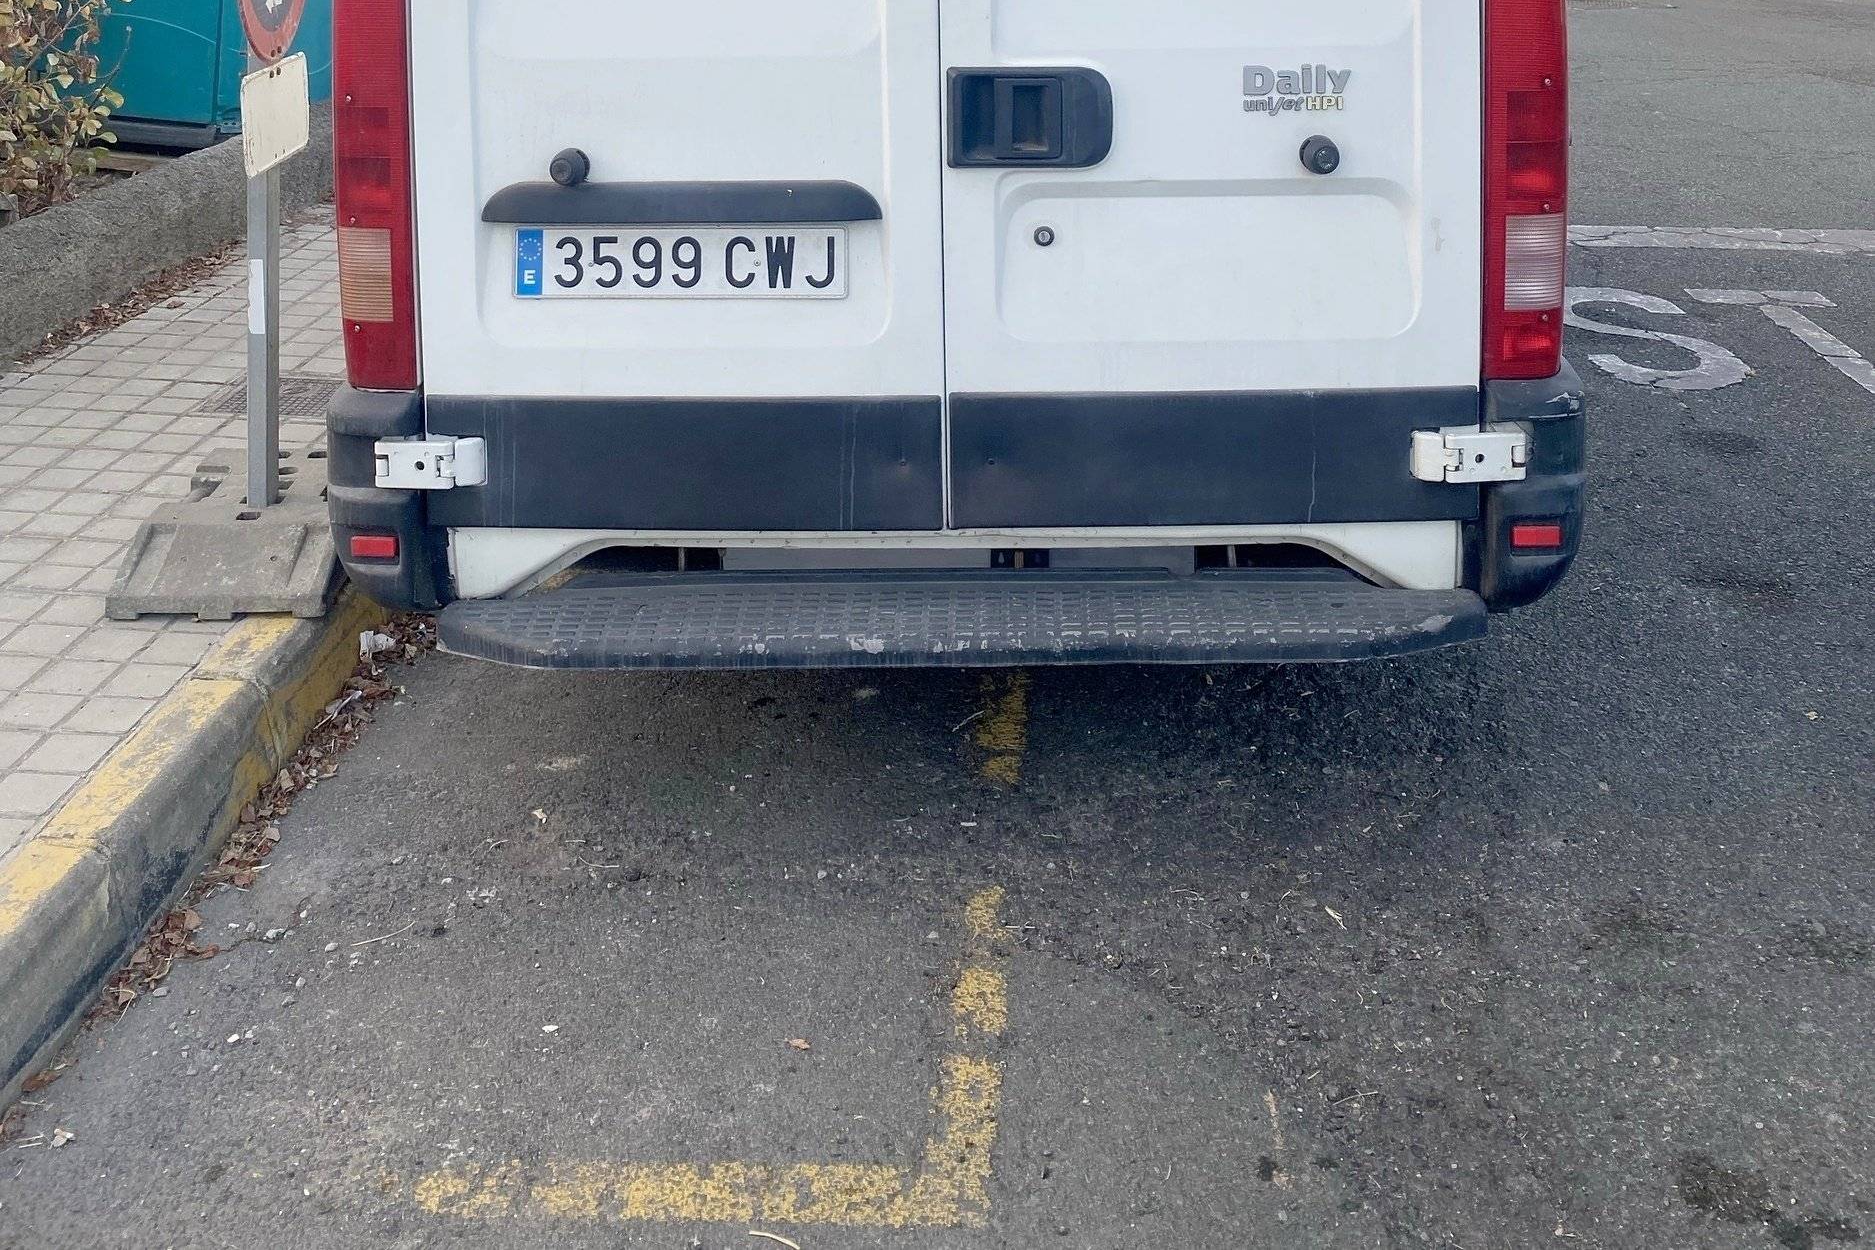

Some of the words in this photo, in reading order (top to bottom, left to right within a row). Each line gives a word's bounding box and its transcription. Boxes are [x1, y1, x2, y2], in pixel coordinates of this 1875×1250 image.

[1243, 63, 1352, 96] Daily
[1306, 95, 1345, 111] HPI
[523, 270, 536, 285] E
[553, 235, 703, 289] 3599
[724, 235, 836, 289] CWJ
